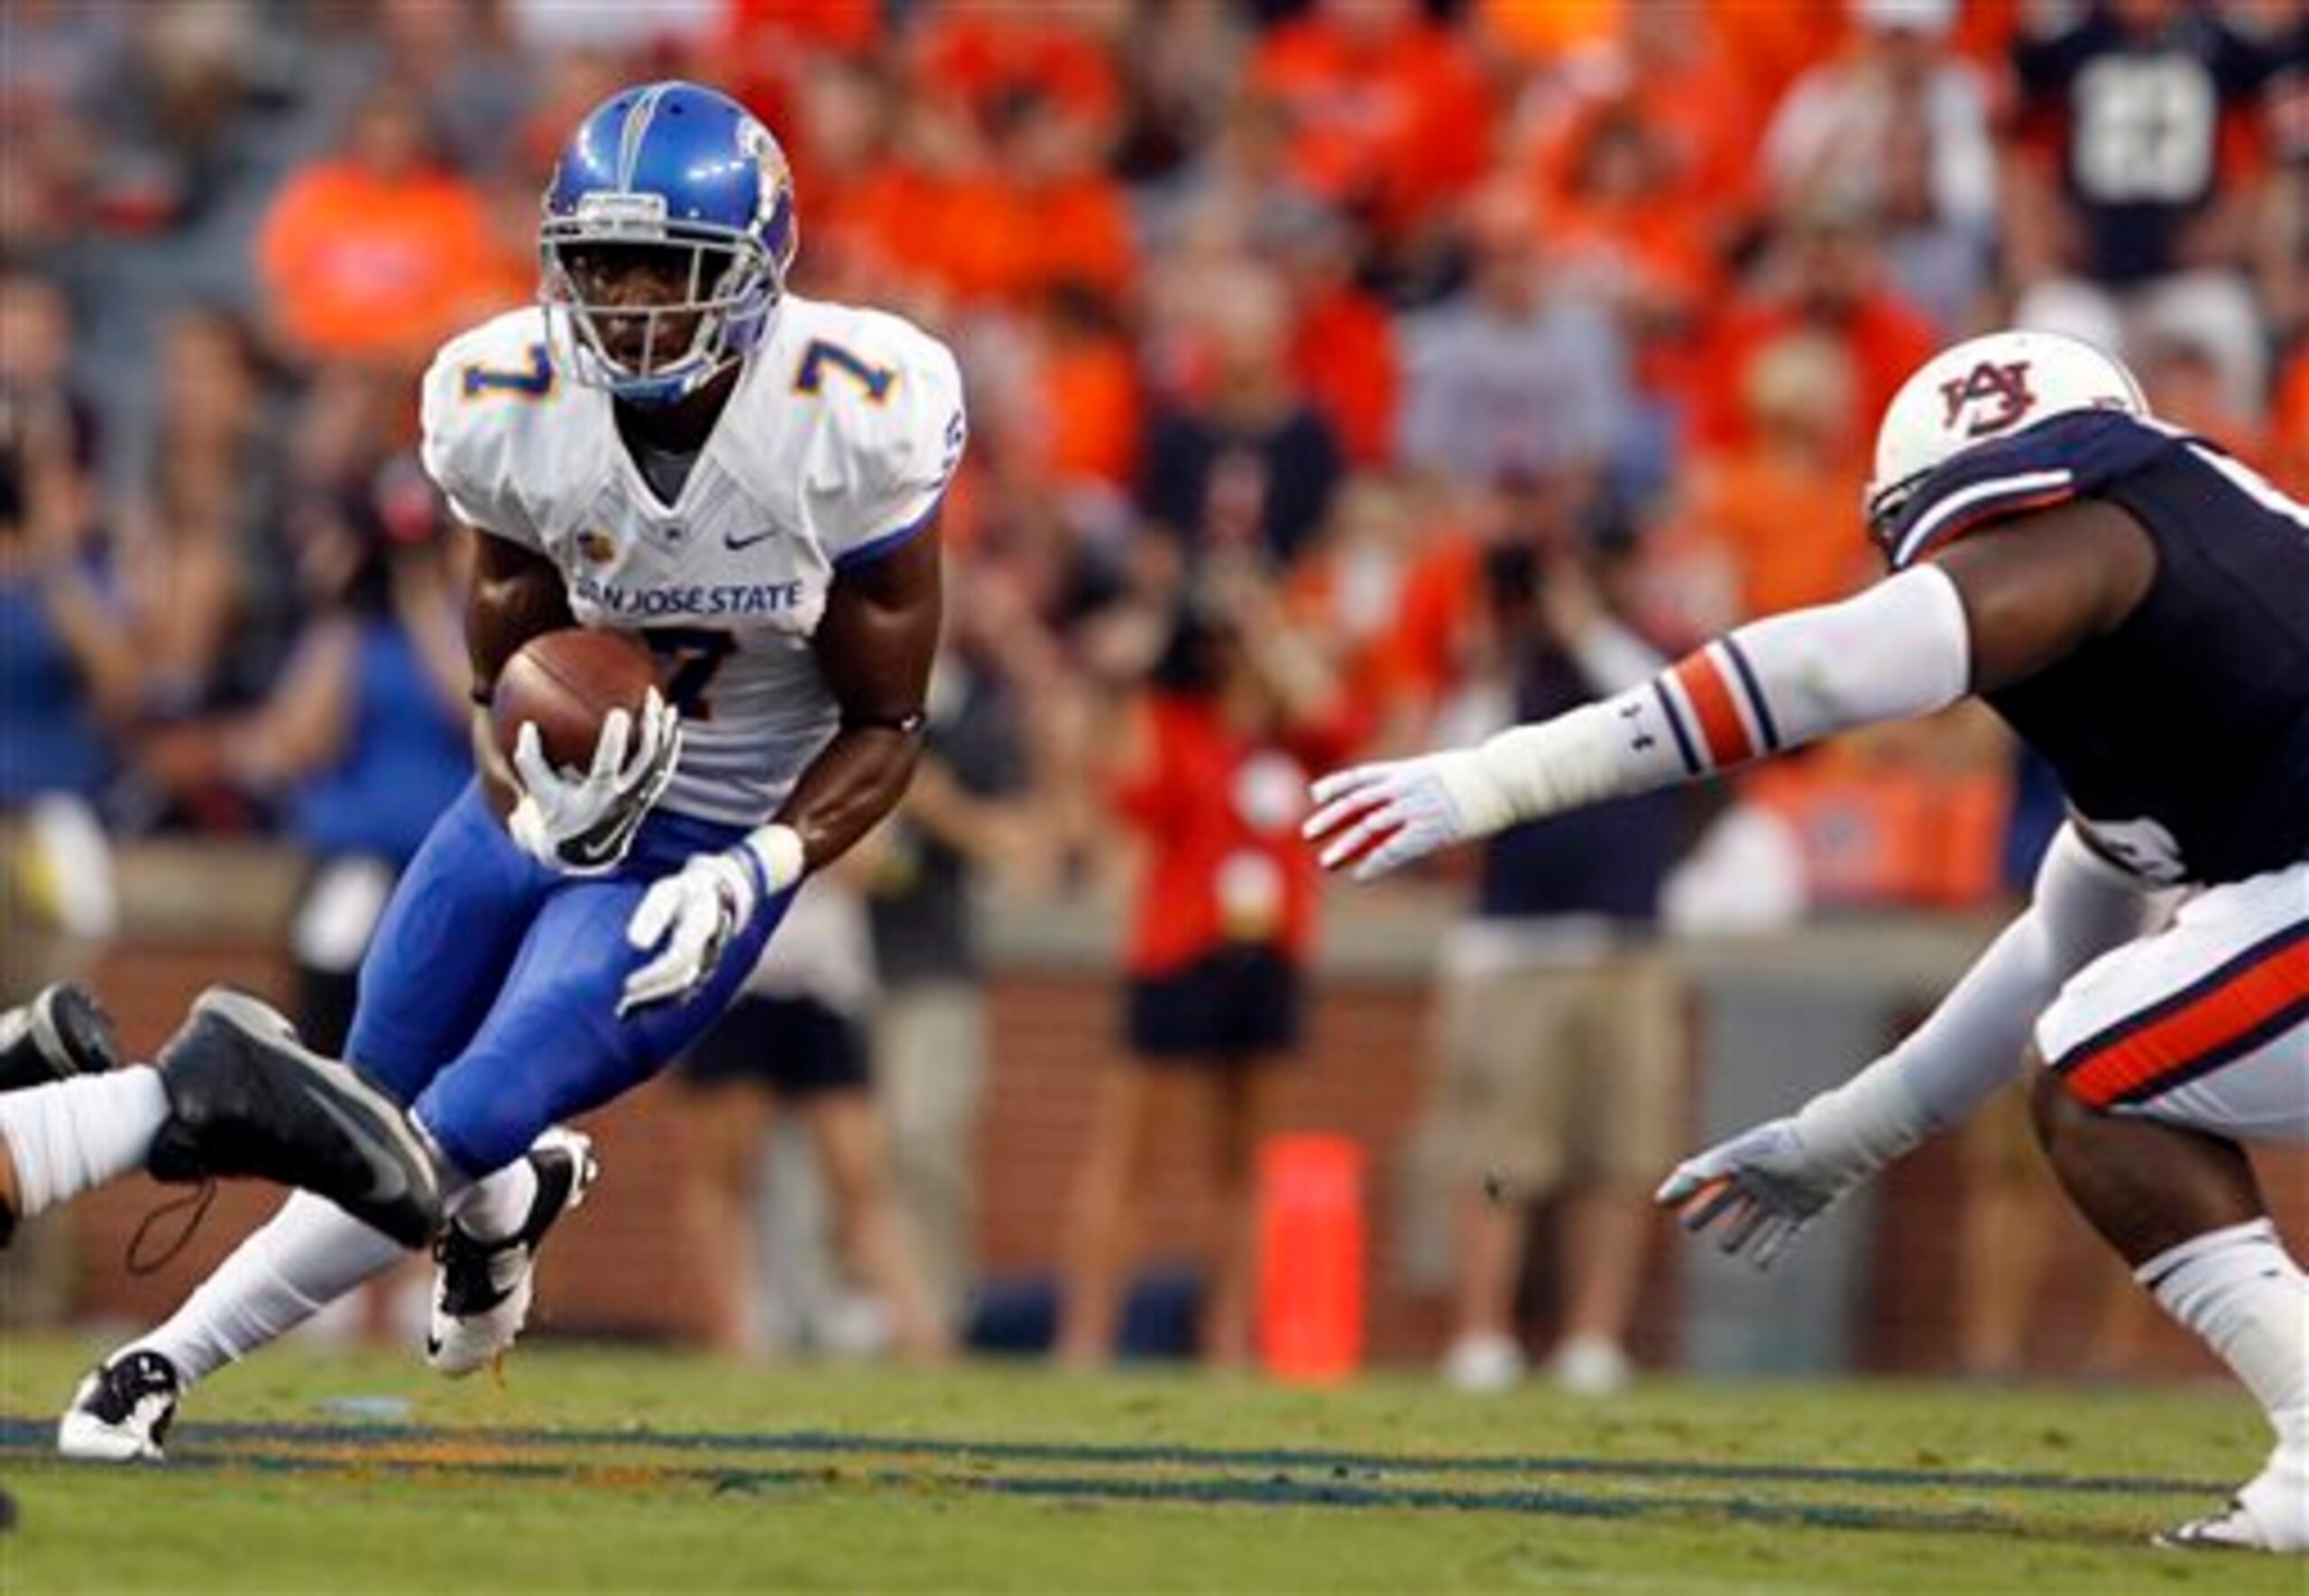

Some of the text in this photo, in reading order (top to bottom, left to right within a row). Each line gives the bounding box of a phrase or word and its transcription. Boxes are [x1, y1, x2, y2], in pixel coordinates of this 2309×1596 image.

[461, 344, 557, 399] 7
[791, 337, 897, 402] 7
[627, 588, 703, 614] JOSE
[707, 581, 801, 613] STATE
